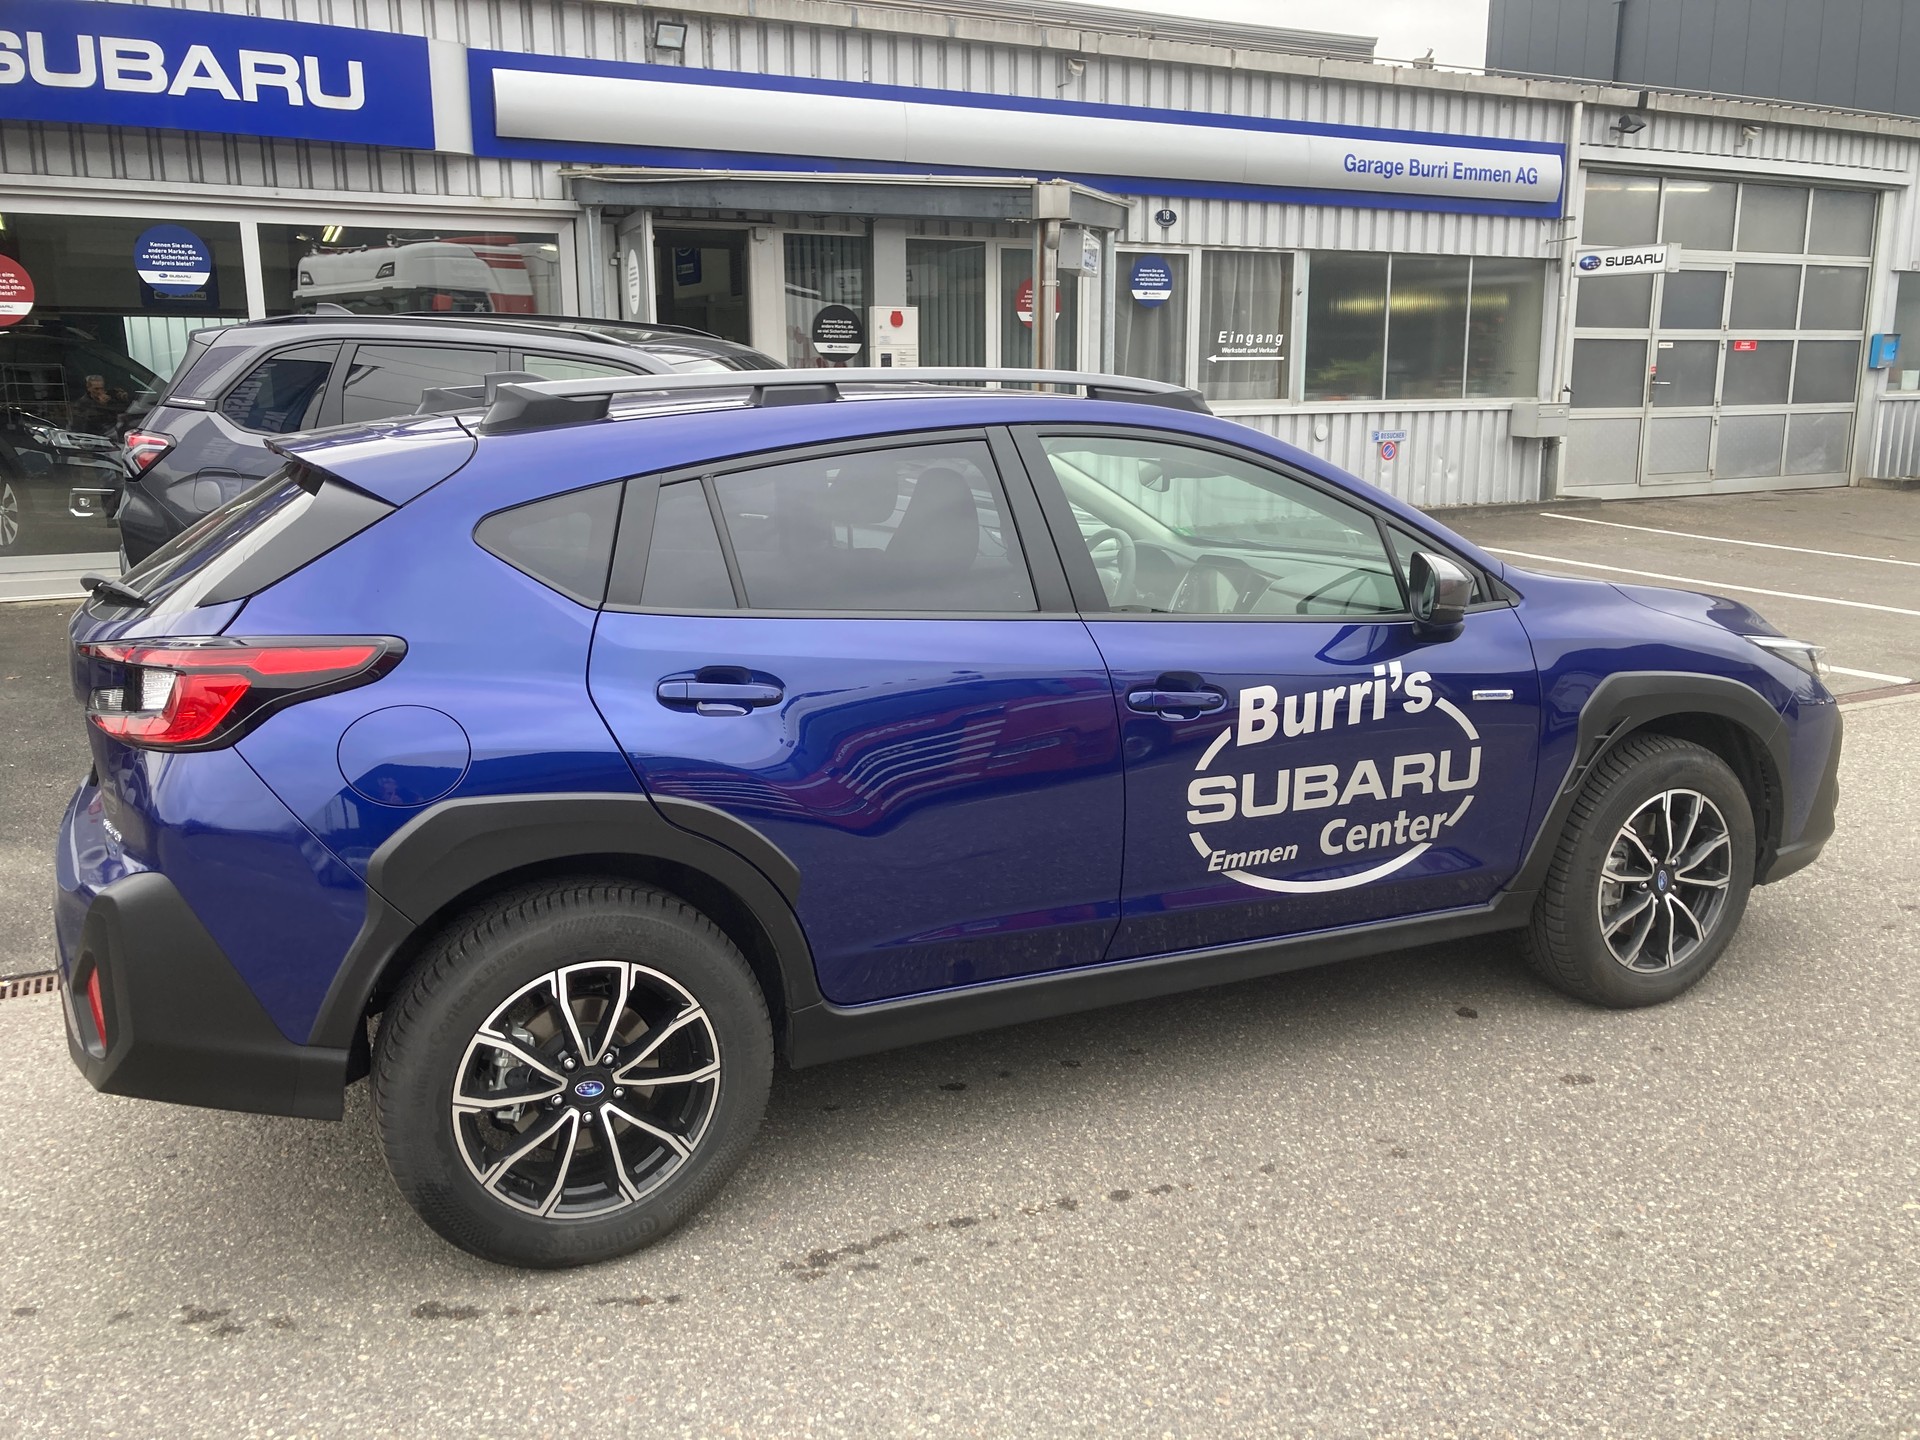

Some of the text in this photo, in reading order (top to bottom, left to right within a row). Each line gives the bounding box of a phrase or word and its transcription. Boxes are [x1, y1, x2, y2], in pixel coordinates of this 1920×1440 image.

[1344, 154, 1538, 184] Garage Burri Emmen AG
[1162, 210, 1170, 220] 18
[1605, 253, 1664, 267] SUBARU
[1218, 330, 1284, 346] Eingang
[1236, 660, 1433, 747] Burri's
[1186, 746, 1481, 825] SUBARU
[1208, 810, 1449, 872] Emmen Center
